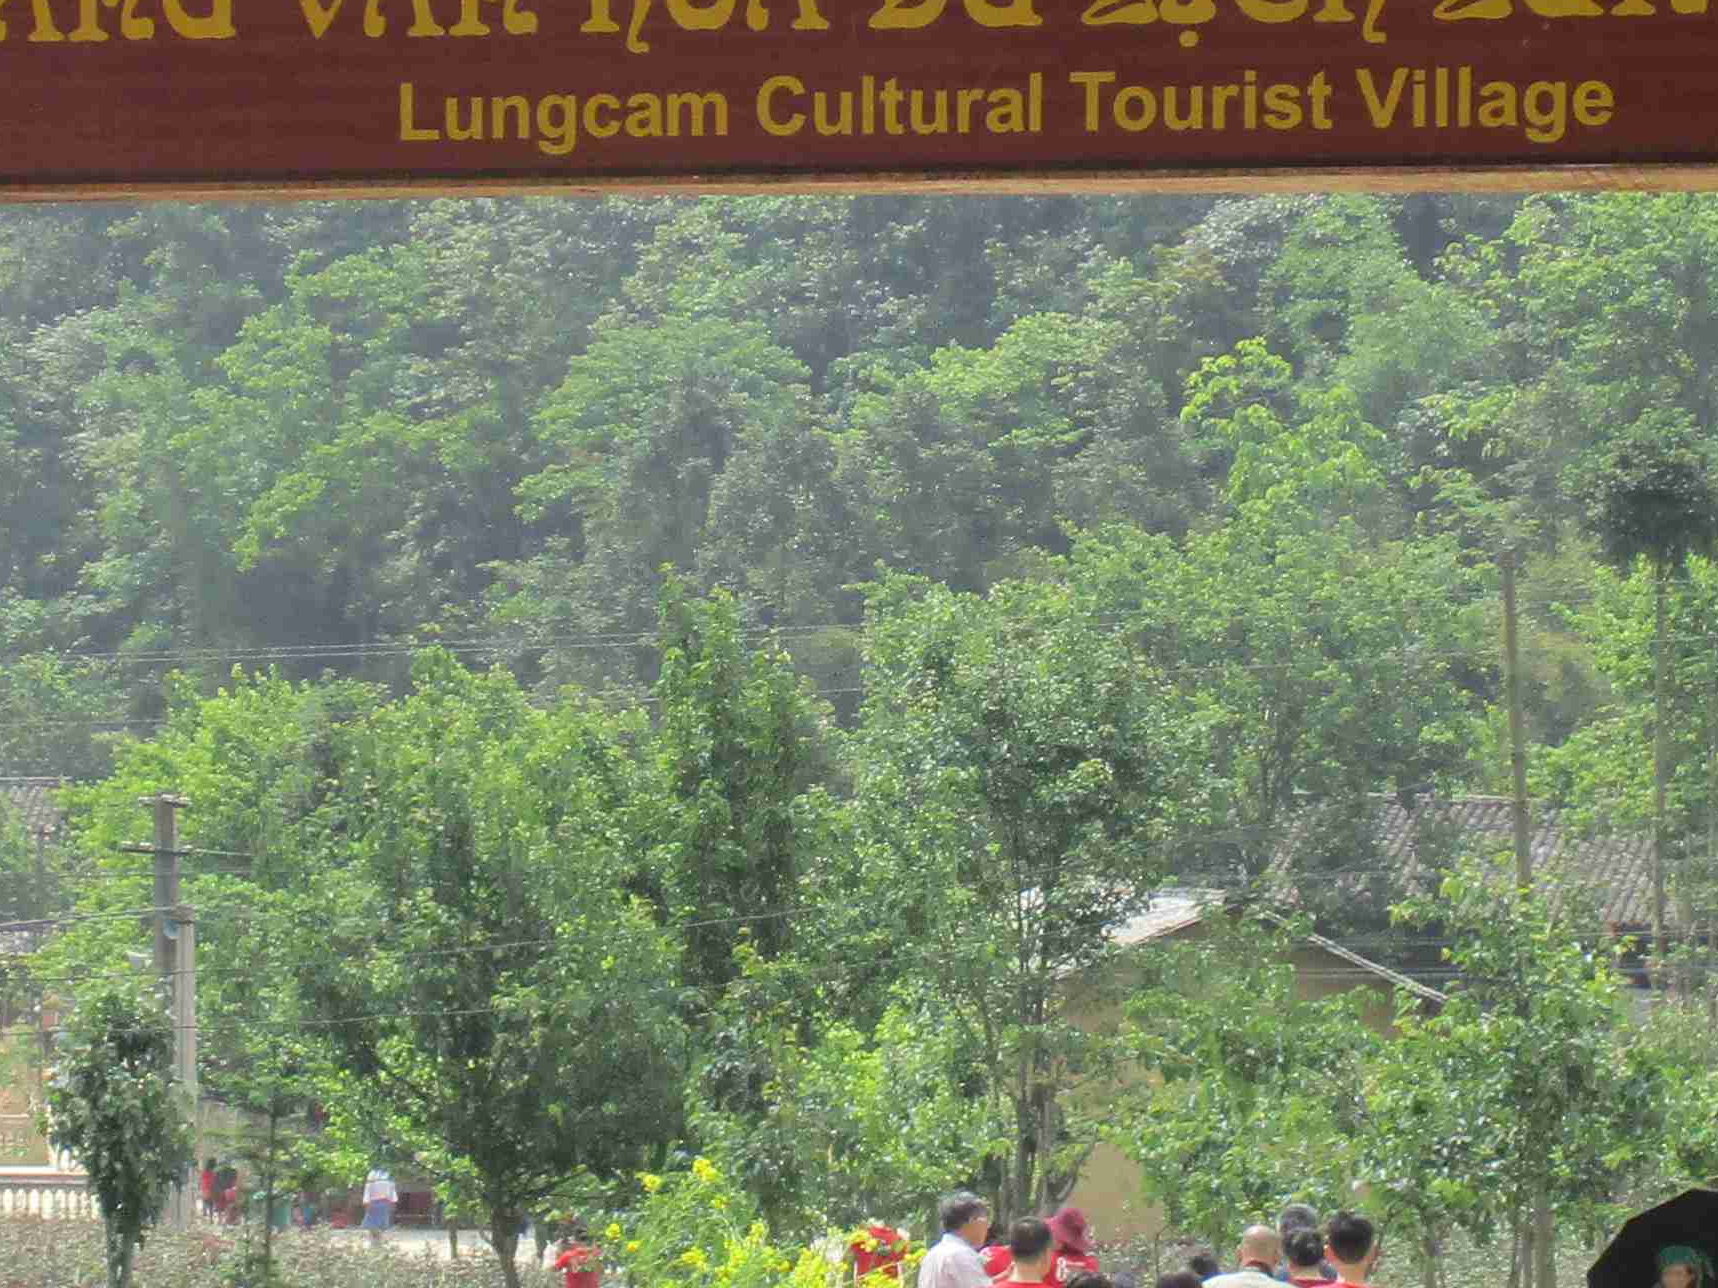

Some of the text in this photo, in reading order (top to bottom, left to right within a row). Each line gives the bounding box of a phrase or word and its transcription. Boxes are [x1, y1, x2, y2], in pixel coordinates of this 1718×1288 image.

[399, 66, 1614, 156] Lungcam Cultural Tourist Village
